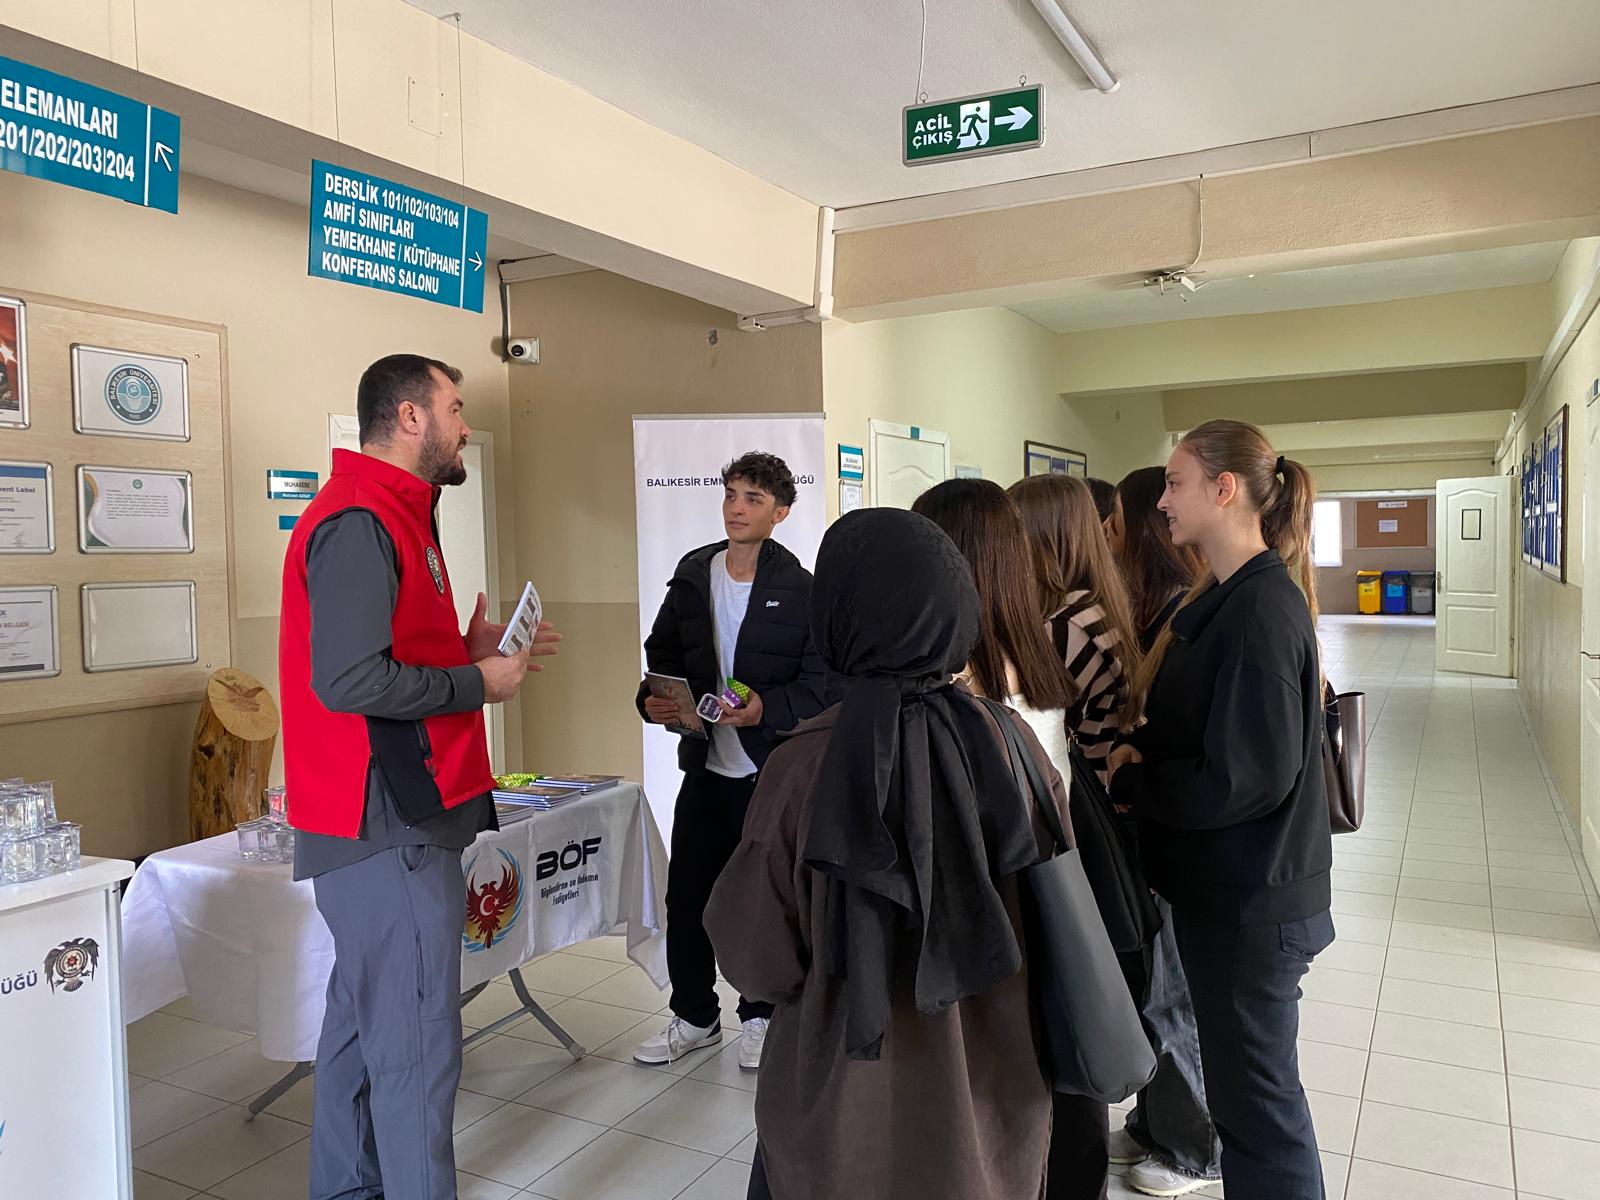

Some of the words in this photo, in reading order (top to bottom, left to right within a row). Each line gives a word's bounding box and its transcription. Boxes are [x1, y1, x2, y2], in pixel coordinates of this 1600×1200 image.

[1, 78, 118, 140] ELEMANLARI
[914, 113, 953, 134] ACİL
[0, 118, 135, 182] 201/202/203/204
[912, 130, 953, 150] ÇIKIŞ
[323, 200, 356, 225] AMFİ
[359, 209, 415, 240] SINIFLARI
[325, 172, 378, 205] DERSLİK
[382, 189, 460, 229] 101/102/103/104
[322, 251, 396, 285] KONFERANS
[398, 268, 440, 295] SALONU
[323, 225, 396, 260] YEMEKHANE
[397, 243, 402, 262] /
[404, 242, 460, 277] KÜTÜPHANE
[646, 476, 701, 487] BALIKESİR
[703, 476, 726, 486] EMN
[792, 474, 814, 485] ÜĞÜ
[536, 837, 602, 881] BÖF
[0, 969, 38, 995] ÜĞÜ
